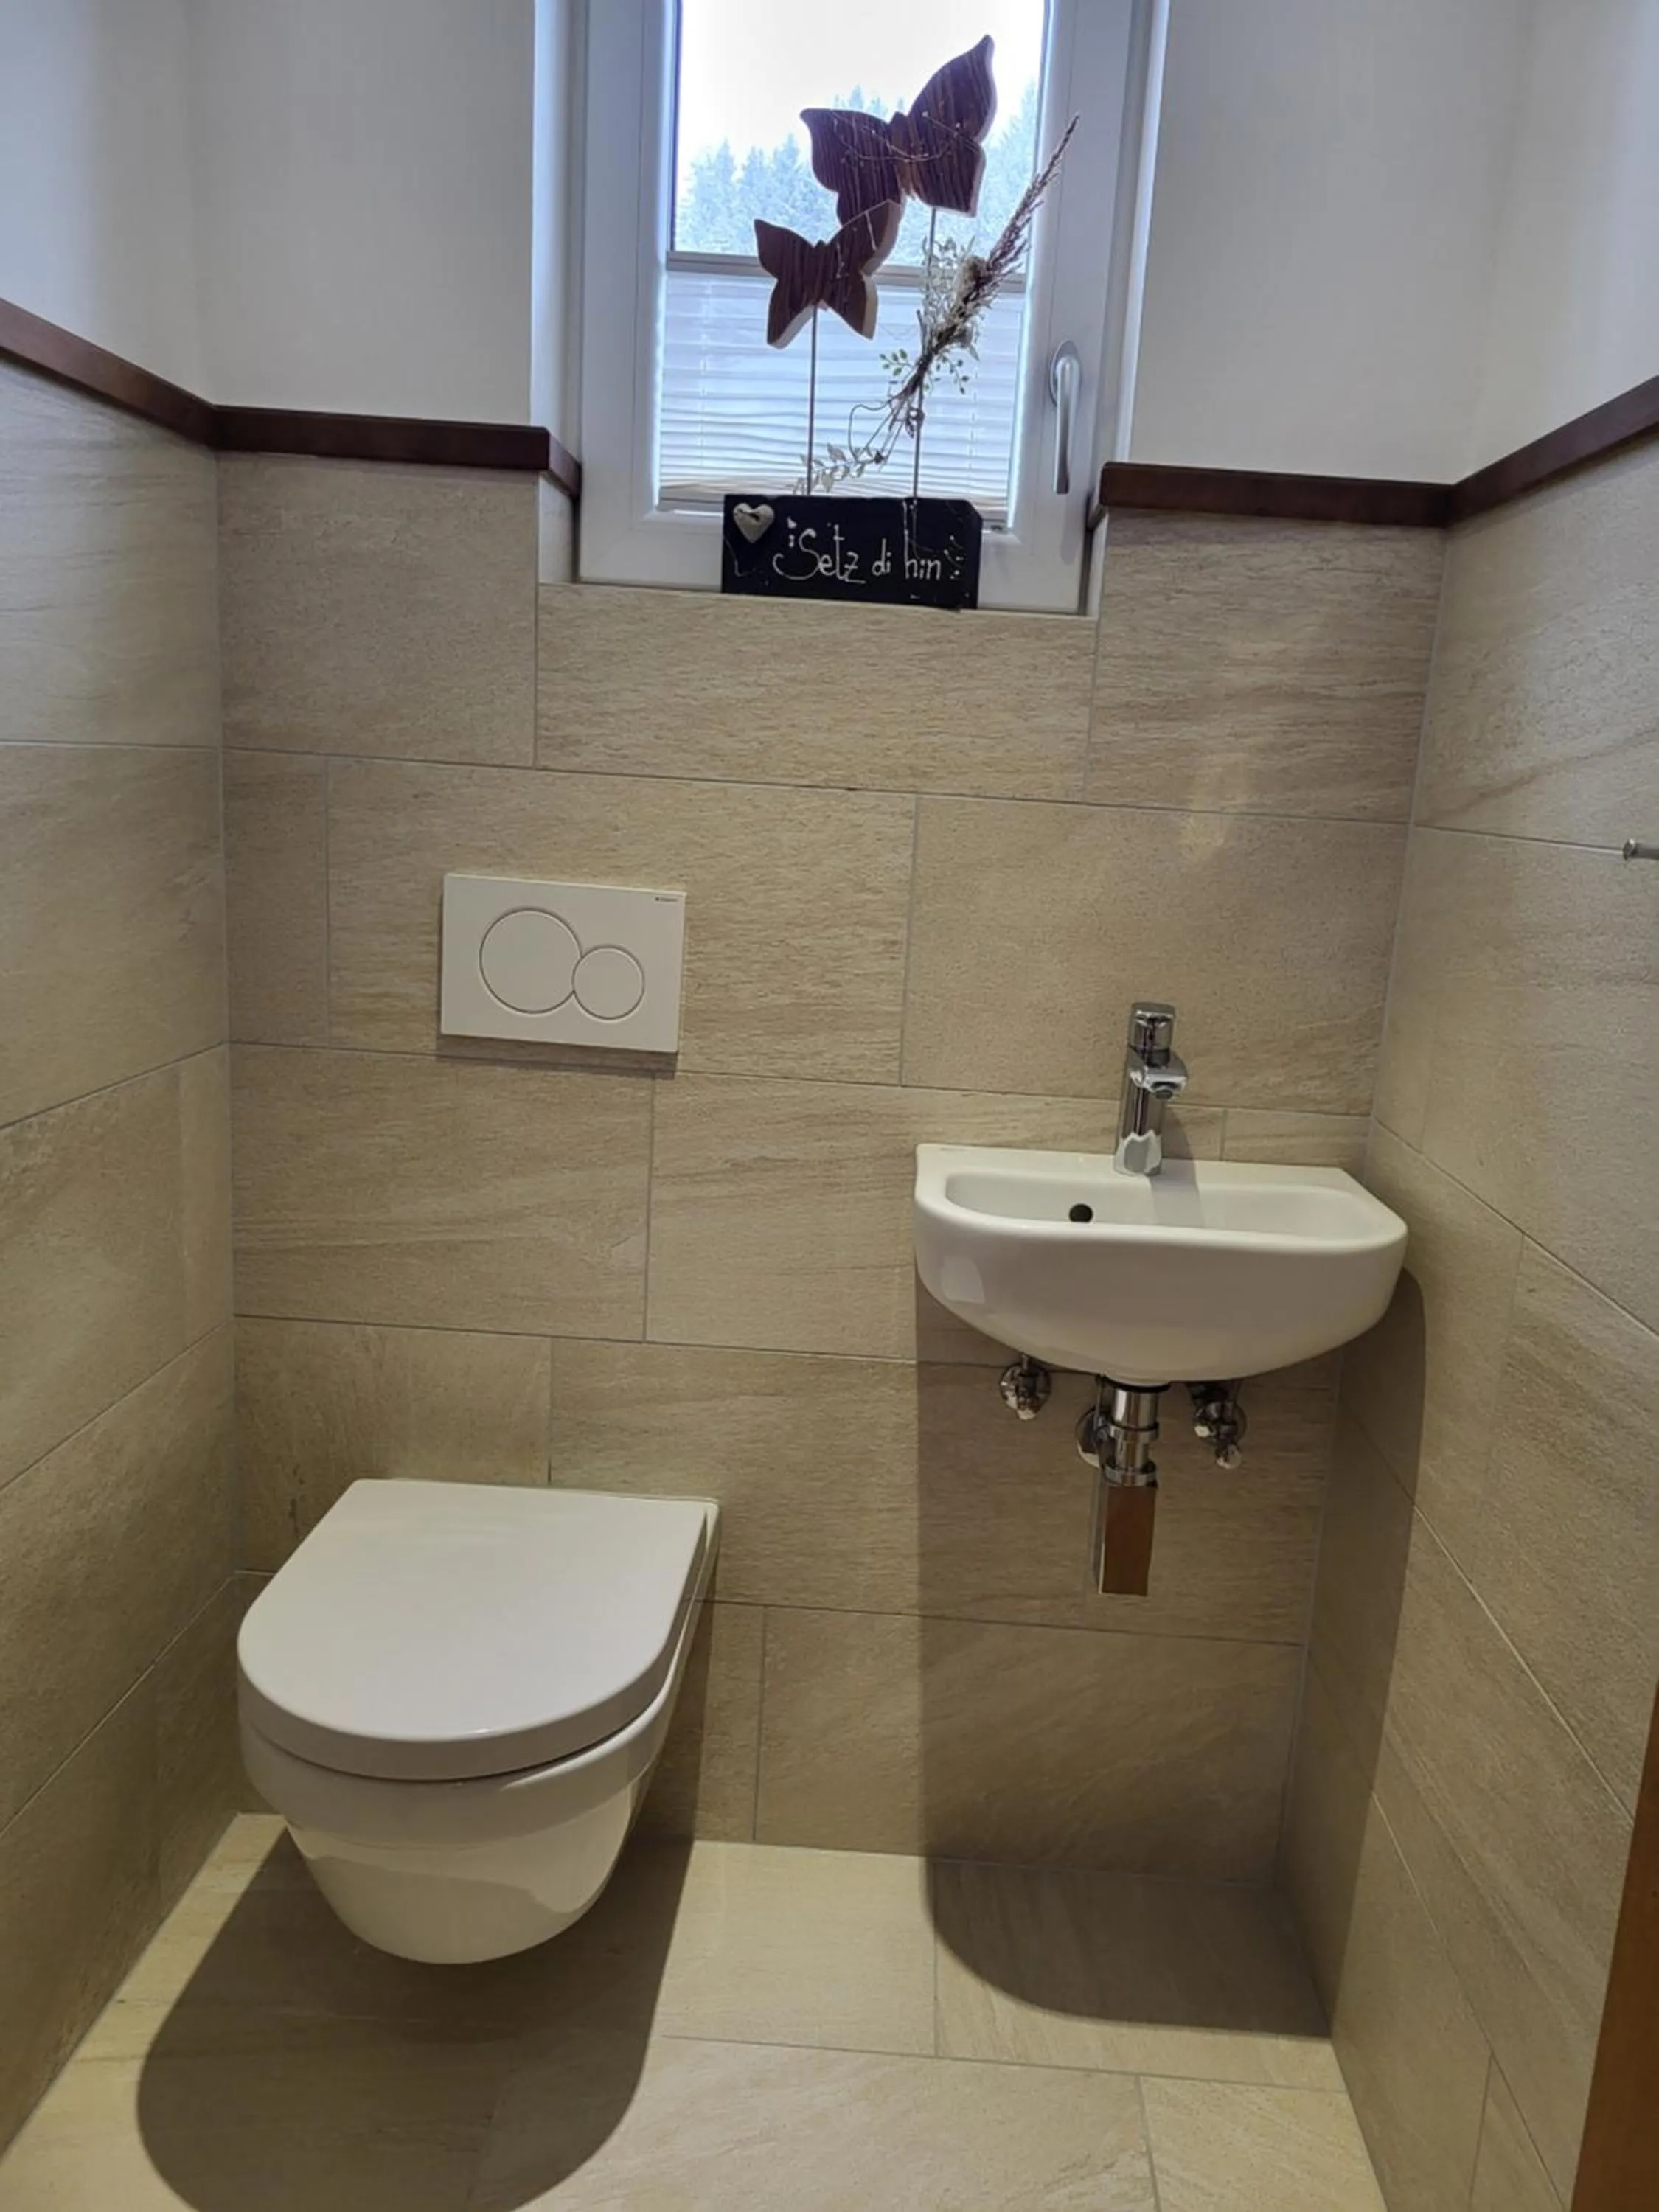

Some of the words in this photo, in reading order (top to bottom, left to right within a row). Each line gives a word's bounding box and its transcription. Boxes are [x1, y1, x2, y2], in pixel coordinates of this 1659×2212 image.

[772, 524, 866, 584] Setz
[872, 538, 891, 577] di
[903, 529, 942, 580] hin
